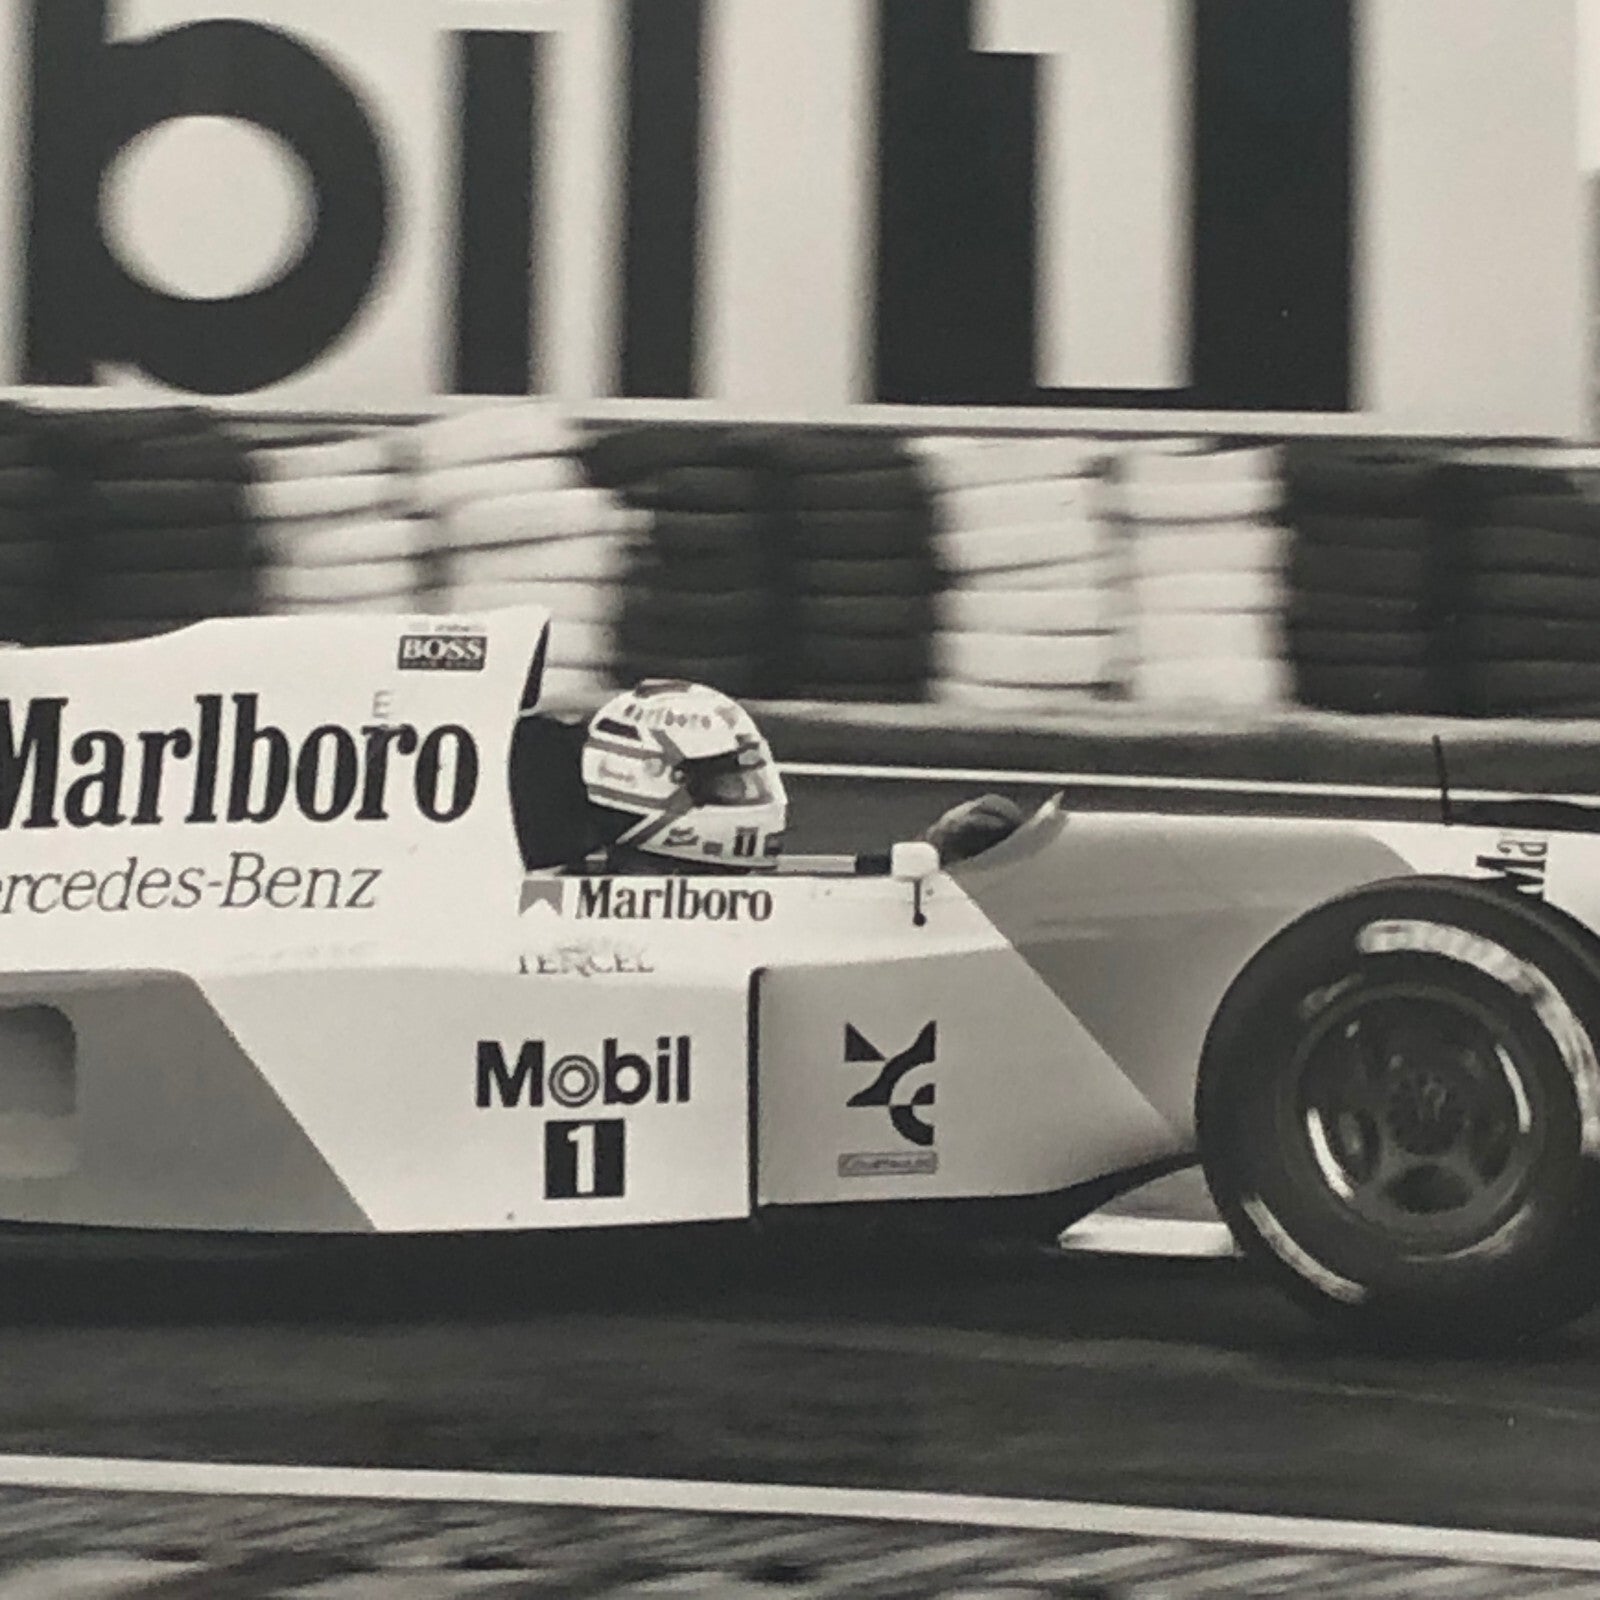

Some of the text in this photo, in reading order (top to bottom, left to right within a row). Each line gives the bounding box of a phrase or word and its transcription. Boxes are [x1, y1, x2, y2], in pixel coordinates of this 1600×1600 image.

[402, 639, 482, 660] BOSS
[0, 693, 479, 830] Marlboro
[0, 852, 381, 914] rcedes-Benz
[575, 879, 773, 920] Marlboro
[476, 1036, 691, 1107] Mobil
